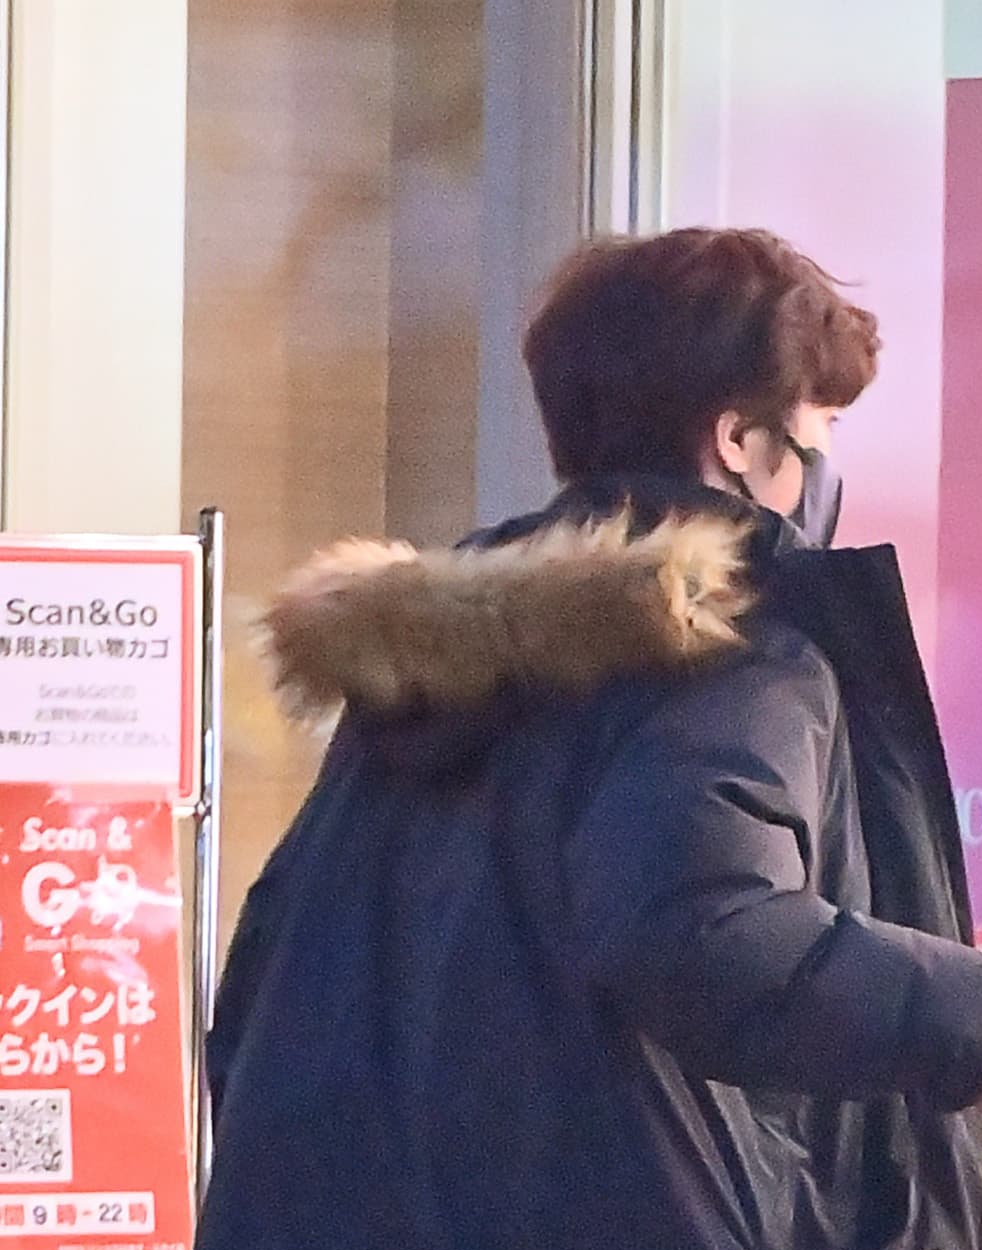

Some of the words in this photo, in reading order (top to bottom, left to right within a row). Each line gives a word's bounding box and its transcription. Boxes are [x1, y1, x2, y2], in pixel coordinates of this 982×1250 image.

[5, 598, 158, 627] Scan&Go
[19, 816, 97, 852] Scan
[106, 816, 133, 850] &
[0, 983, 156, 1027] クインは
